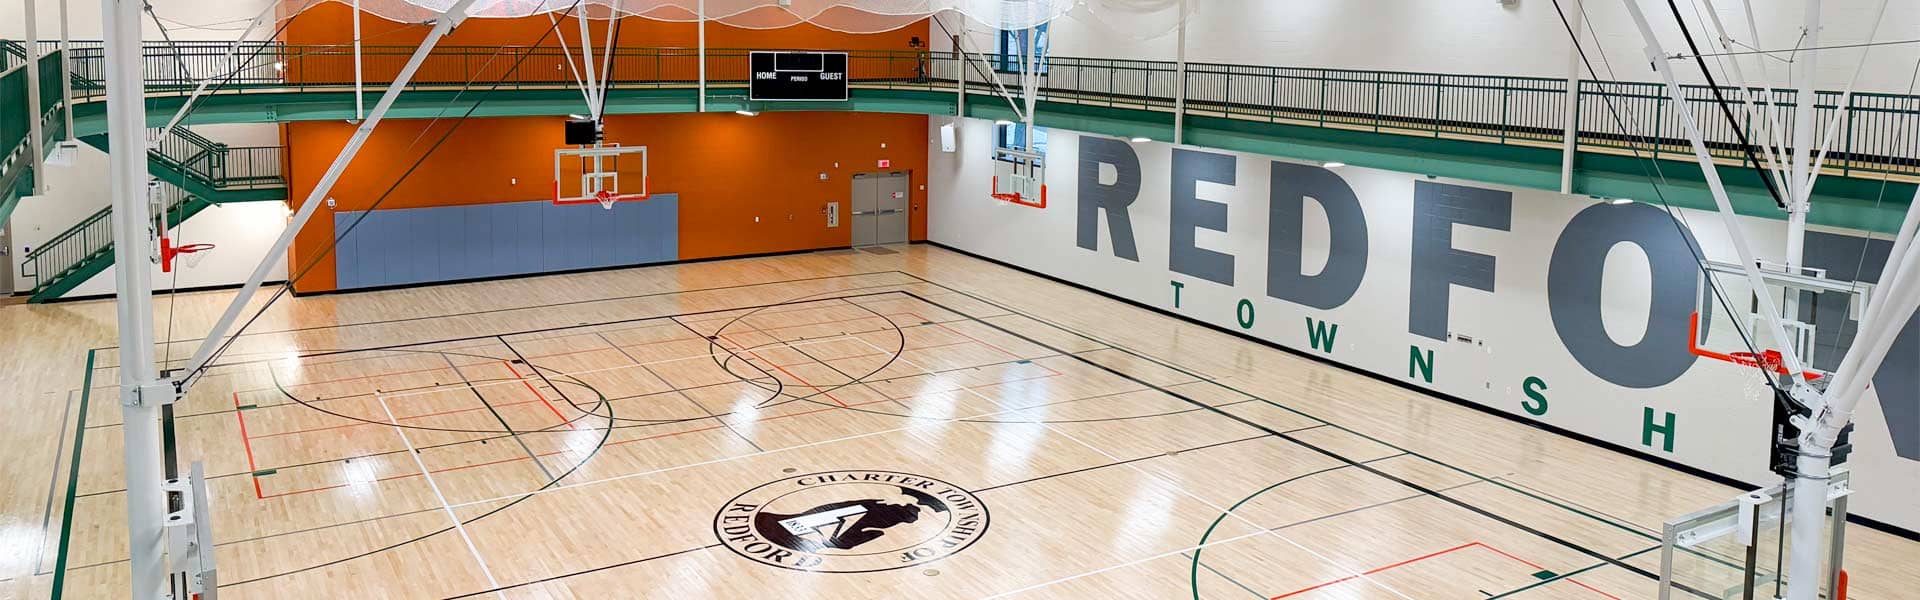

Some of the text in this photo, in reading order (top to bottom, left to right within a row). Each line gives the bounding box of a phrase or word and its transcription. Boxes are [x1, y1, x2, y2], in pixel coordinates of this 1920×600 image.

[756, 71, 843, 80] HOME GUEST
[797, 473, 935, 489] CHARTER
[937, 487, 980, 548] TOWNSHIP
